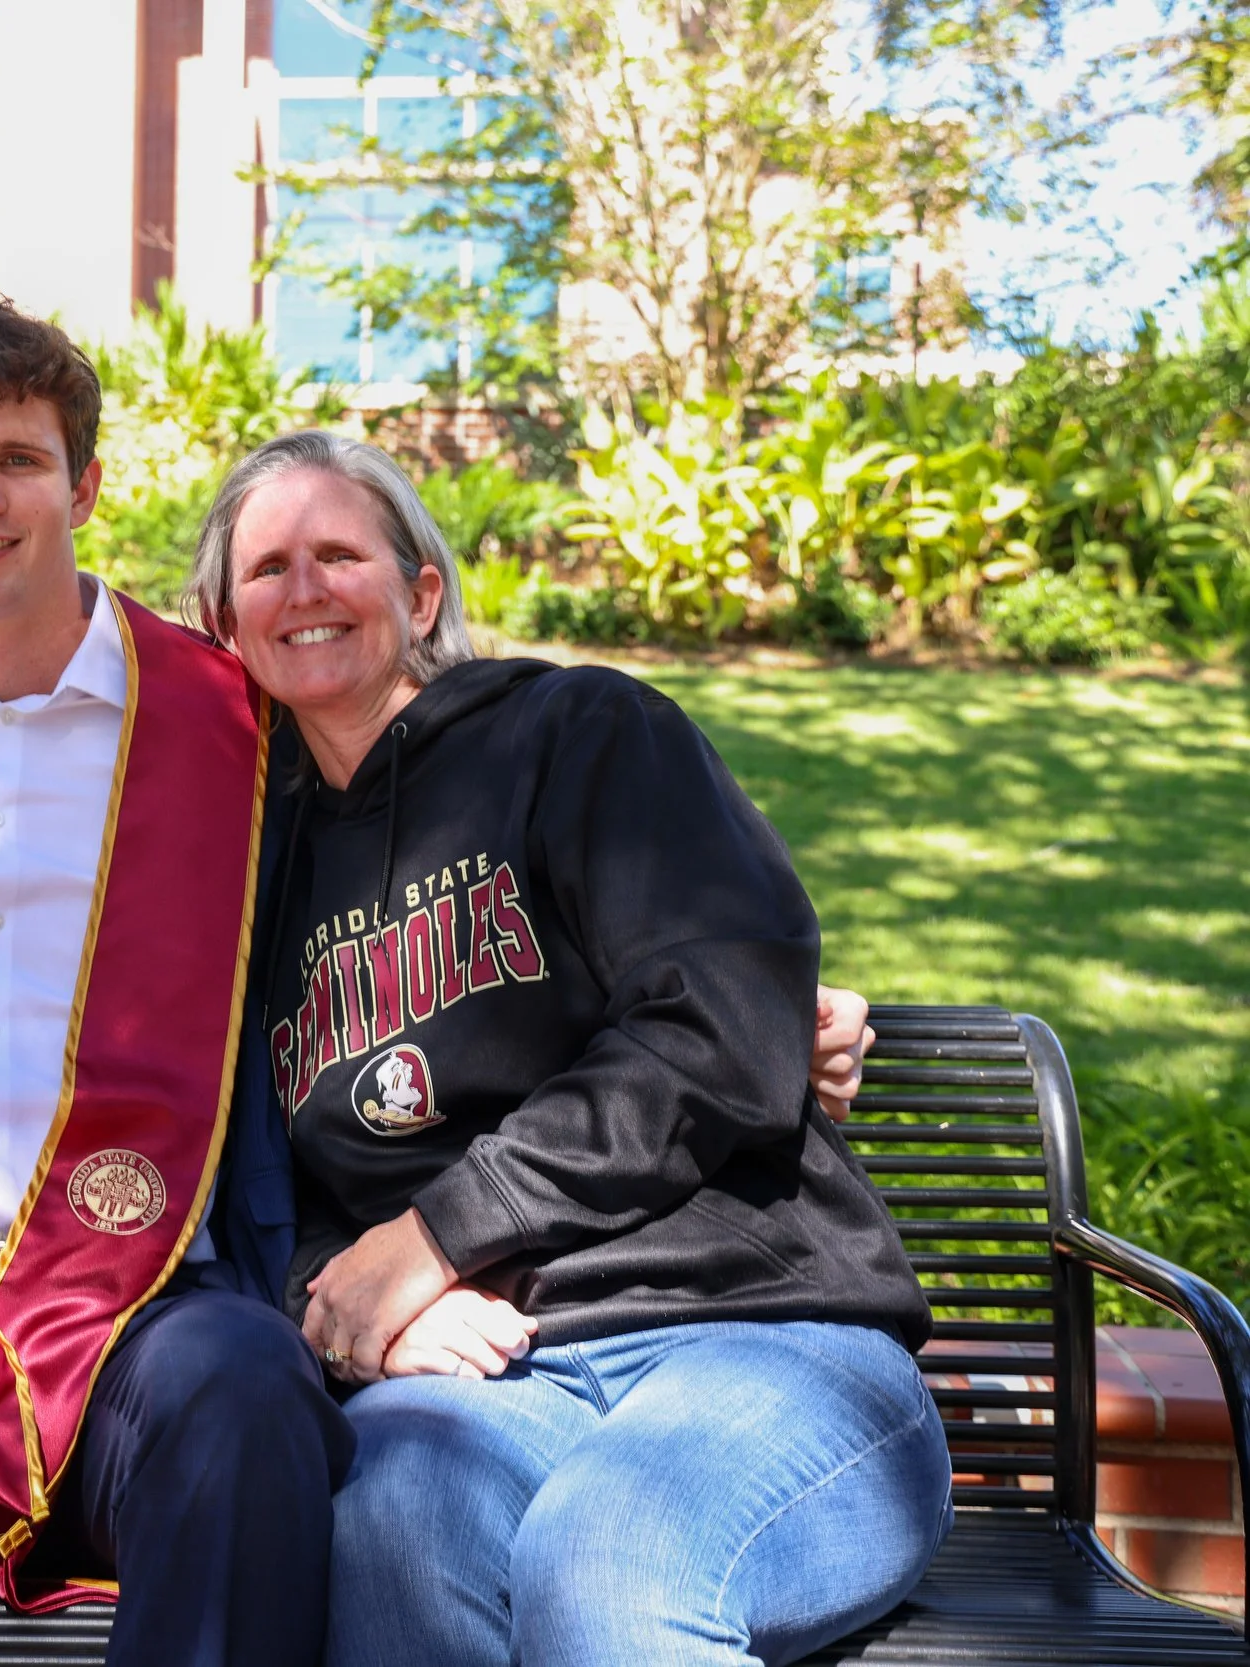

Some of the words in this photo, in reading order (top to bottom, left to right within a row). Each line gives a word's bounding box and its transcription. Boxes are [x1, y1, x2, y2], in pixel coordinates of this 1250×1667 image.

[300, 901, 389, 997] LORID
[405, 852, 491, 908] STATE
[271, 861, 545, 1139] SEMINOLES
[71, 1160, 98, 1206] FLORIDA
[99, 1152, 138, 1166] STATE
[138, 1161, 163, 1225] UNIVERSITY
